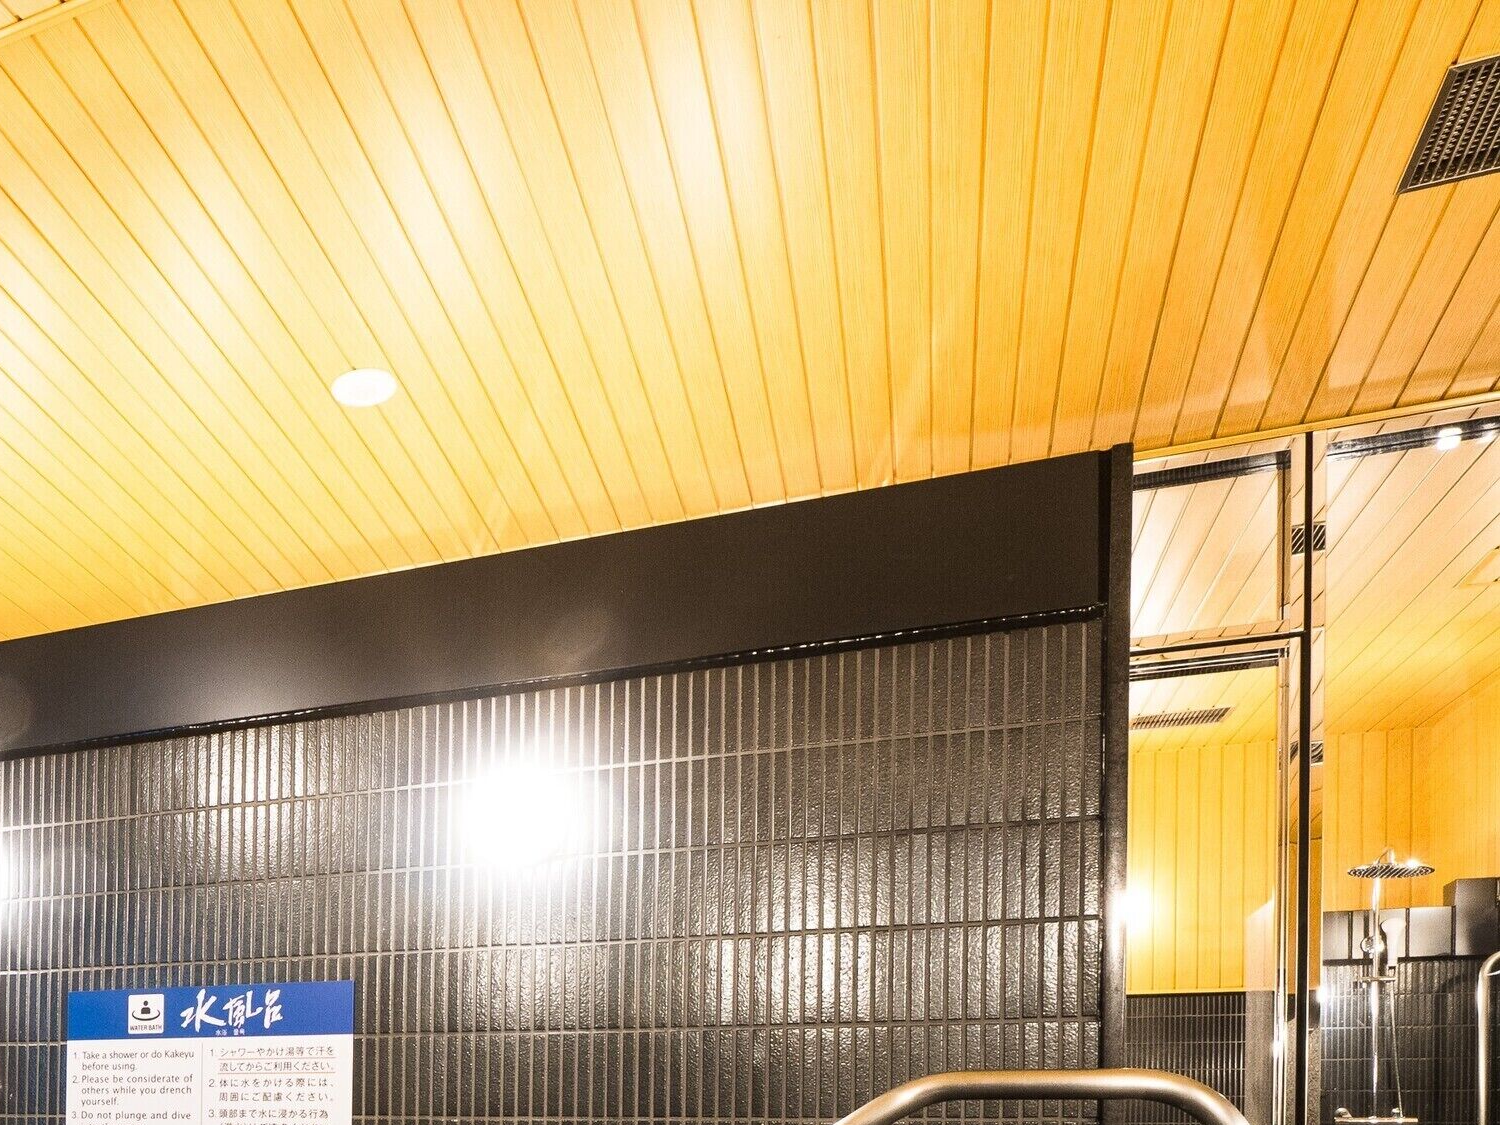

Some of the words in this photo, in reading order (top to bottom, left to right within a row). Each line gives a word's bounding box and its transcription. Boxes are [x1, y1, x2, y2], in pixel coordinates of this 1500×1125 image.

[180, 988, 284, 1033] 水風呂
[82, 1051, 100, 1059] Take
[109, 1051, 138, 1059] shower
[140, 1051, 149, 1059] or
[151, 1050, 163, 1059] do
[164, 1049, 195, 1060] Kakeyu
[81, 1062, 109, 1071] before
[112, 1063, 138, 1072] using.
[219, 1061, 334, 1072] 流してからご利用ください。
[81, 1074, 110, 1084] Please
[112, 1074, 123, 1083] be
[126, 1074, 180, 1083] considerate
[183, 1073, 193, 1083] of
[81, 1086, 110, 1095] others
[112, 1086, 137, 1094] while
[139, 1087, 156, 1096] you
[159, 1085, 192, 1094] drench
[81, 1097, 119, 1107] yourself.
[81, 1111, 94, 1119] Do
[96, 1111, 112, 1119] not
[115, 1111, 147, 1121] plunge
[150, 1111, 168, 1120] and
[171, 1111, 191, 1120] dive
